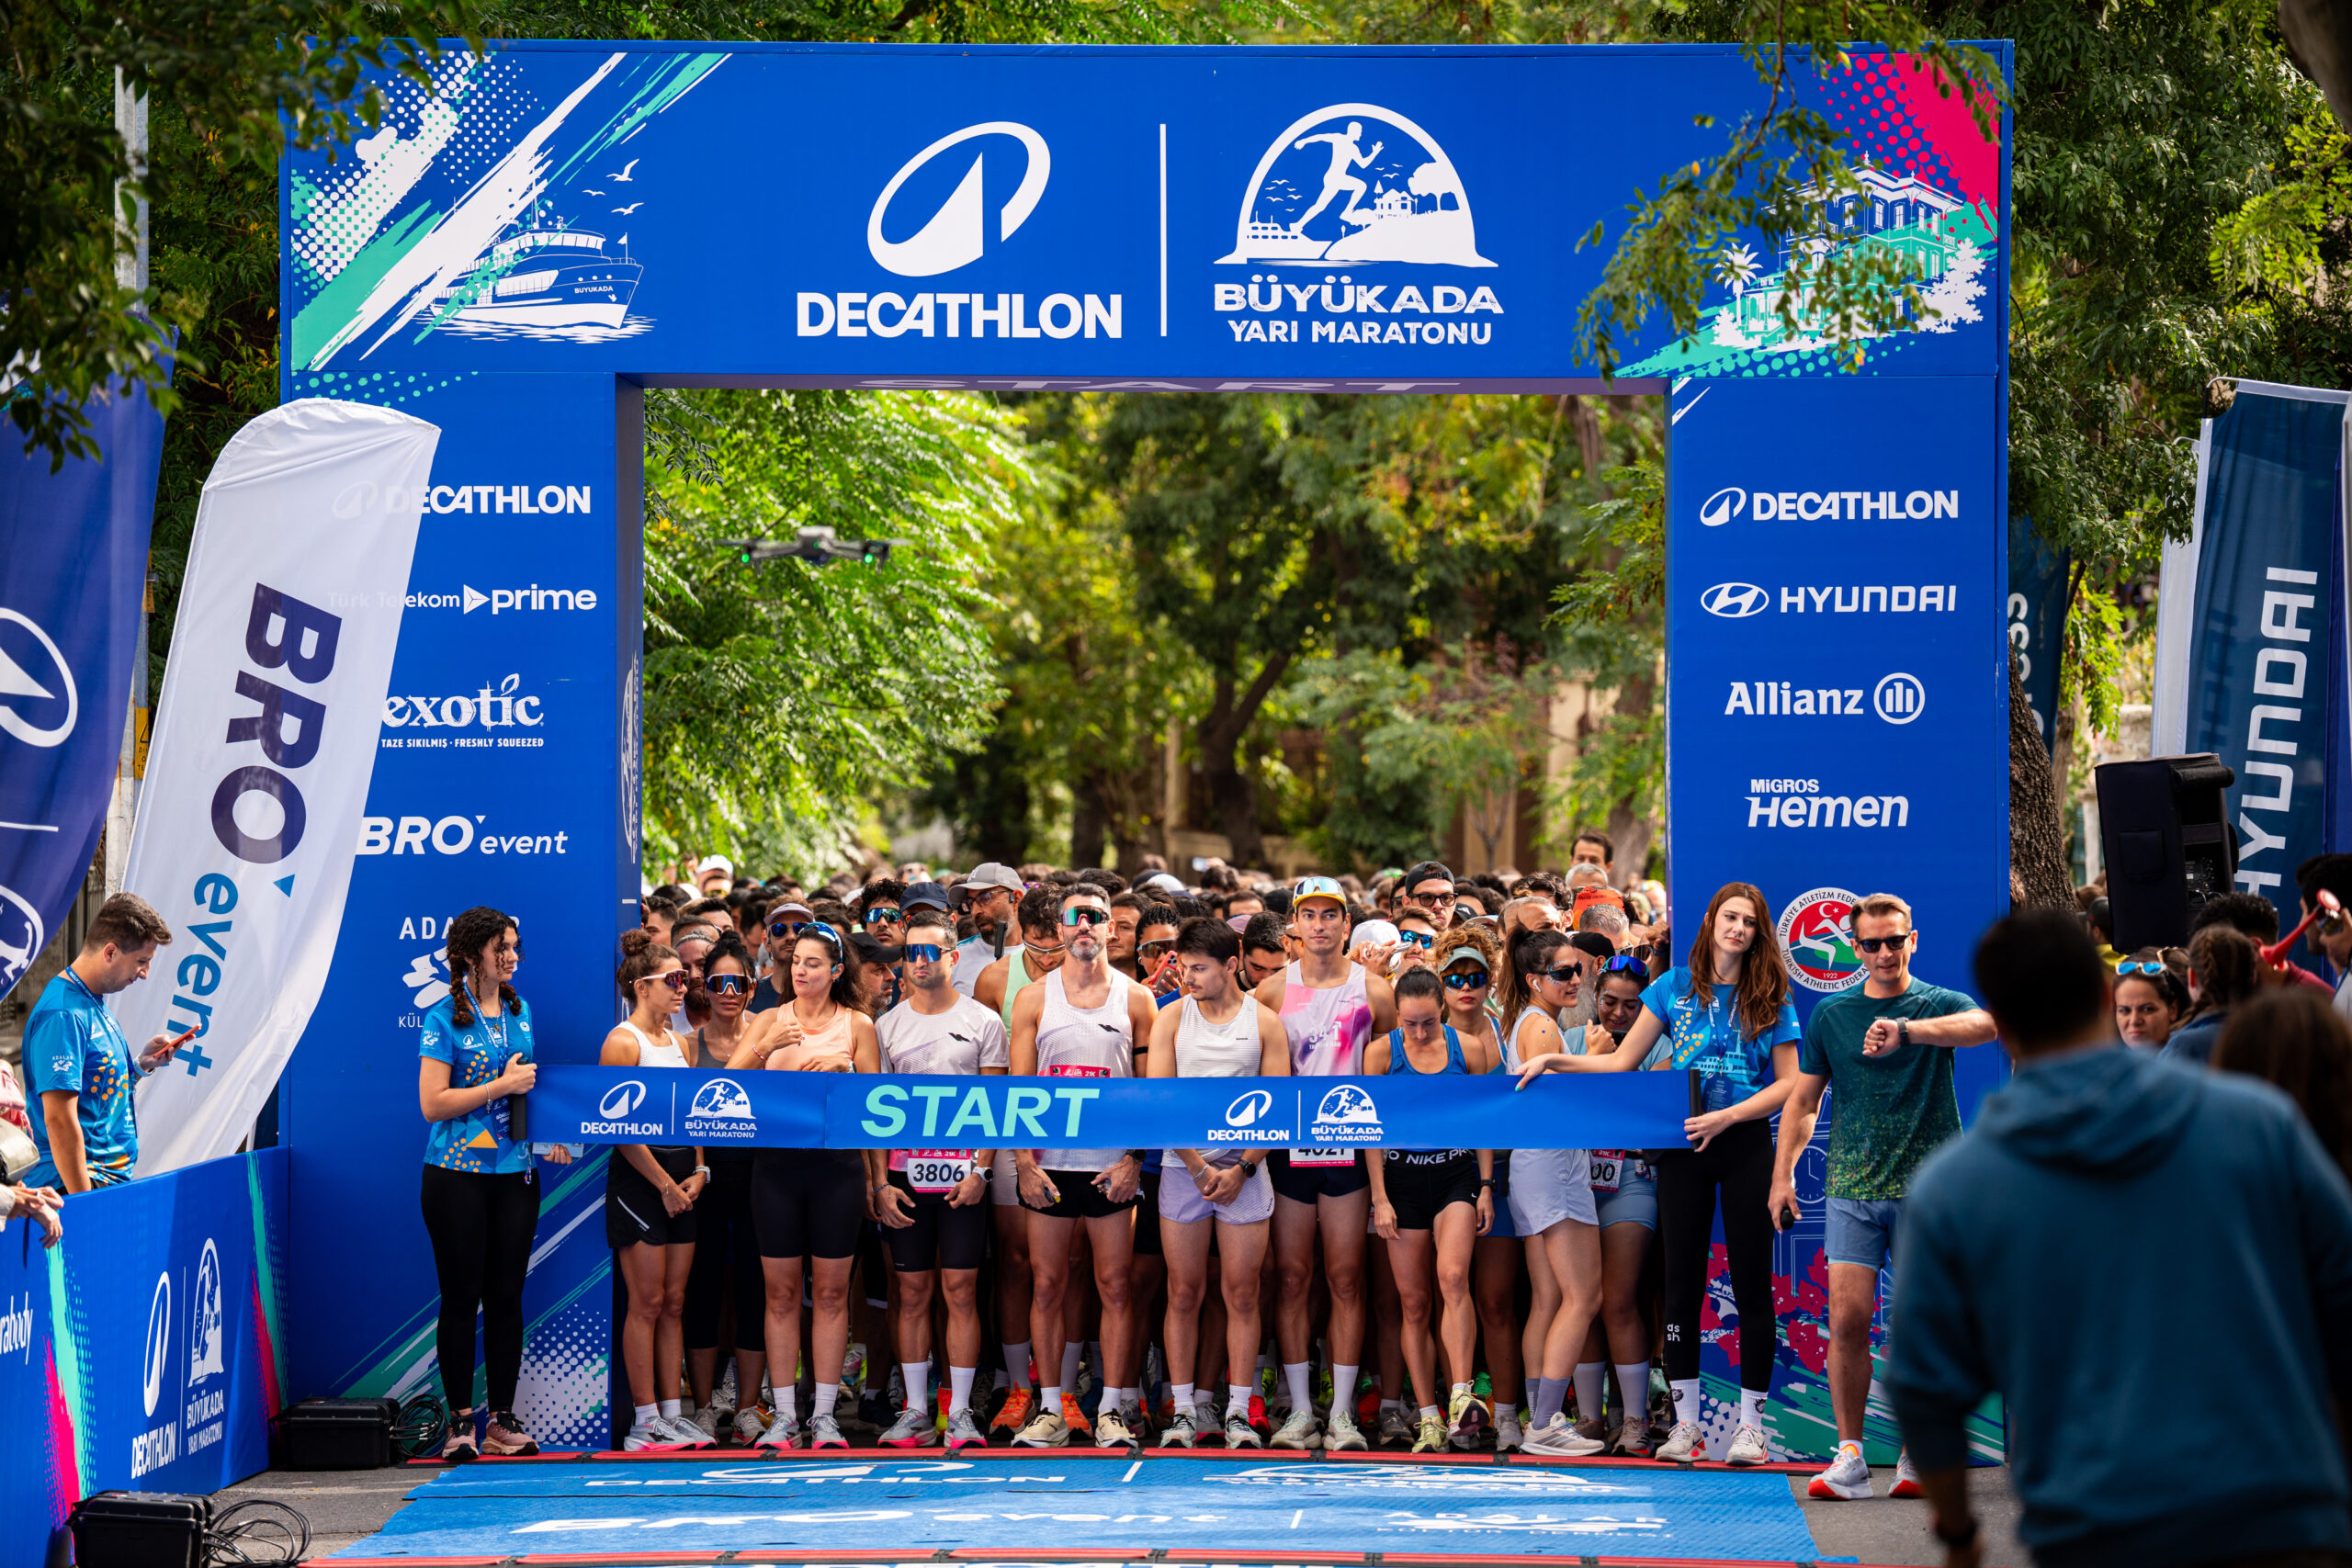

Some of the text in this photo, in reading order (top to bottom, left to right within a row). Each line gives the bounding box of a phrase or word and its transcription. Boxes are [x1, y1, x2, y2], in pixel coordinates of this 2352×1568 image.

[1214, 275, 1504, 315] BÜYÜKADA
[797, 292, 1122, 340] DECATHLON
[1227, 321, 1492, 345] YARI MARATONU
[854, 379, 1461, 391] START
[1753, 490, 1959, 521] DECATHLON
[492, 583, 597, 615] prime
[1780, 585, 1957, 613] HYUNDAI
[1724, 681, 1864, 715] Allianz
[210, 582, 343, 864] BRO
[381, 739, 403, 748] TAZE
[455, 738, 494, 748] FRESHLY
[497, 738, 544, 748] SQUEEZED
[1744, 795, 1909, 827] Hemen
[356, 816, 569, 855] BRO event
[1798, 890, 1835, 908] ATLETİZM
[1838, 892, 1857, 905] FEDE
[160, 873, 239, 1077] event
[1803, 976, 1840, 990] ATHLETIC
[1841, 965, 1871, 987] FEDERA
[861, 1084, 1101, 1138] START
[581, 1122, 662, 1135] DECATHLON
[684, 1120, 757, 1131] BÜYÜKADA
[1207, 1129, 1289, 1141] DECATHLON
[1311, 1125, 1384, 1135] BÜYÜKADA
[1406, 1152, 1447, 1166] NIKE
[912, 1163, 965, 1183] 3806
[187, 1389, 224, 1429] BÜYÜKADA
[130, 1421, 176, 1480] DECATHLON
[583, 1476, 1067, 1486] DECATHLON
[509, 1510, 1228, 1534] BRO event
